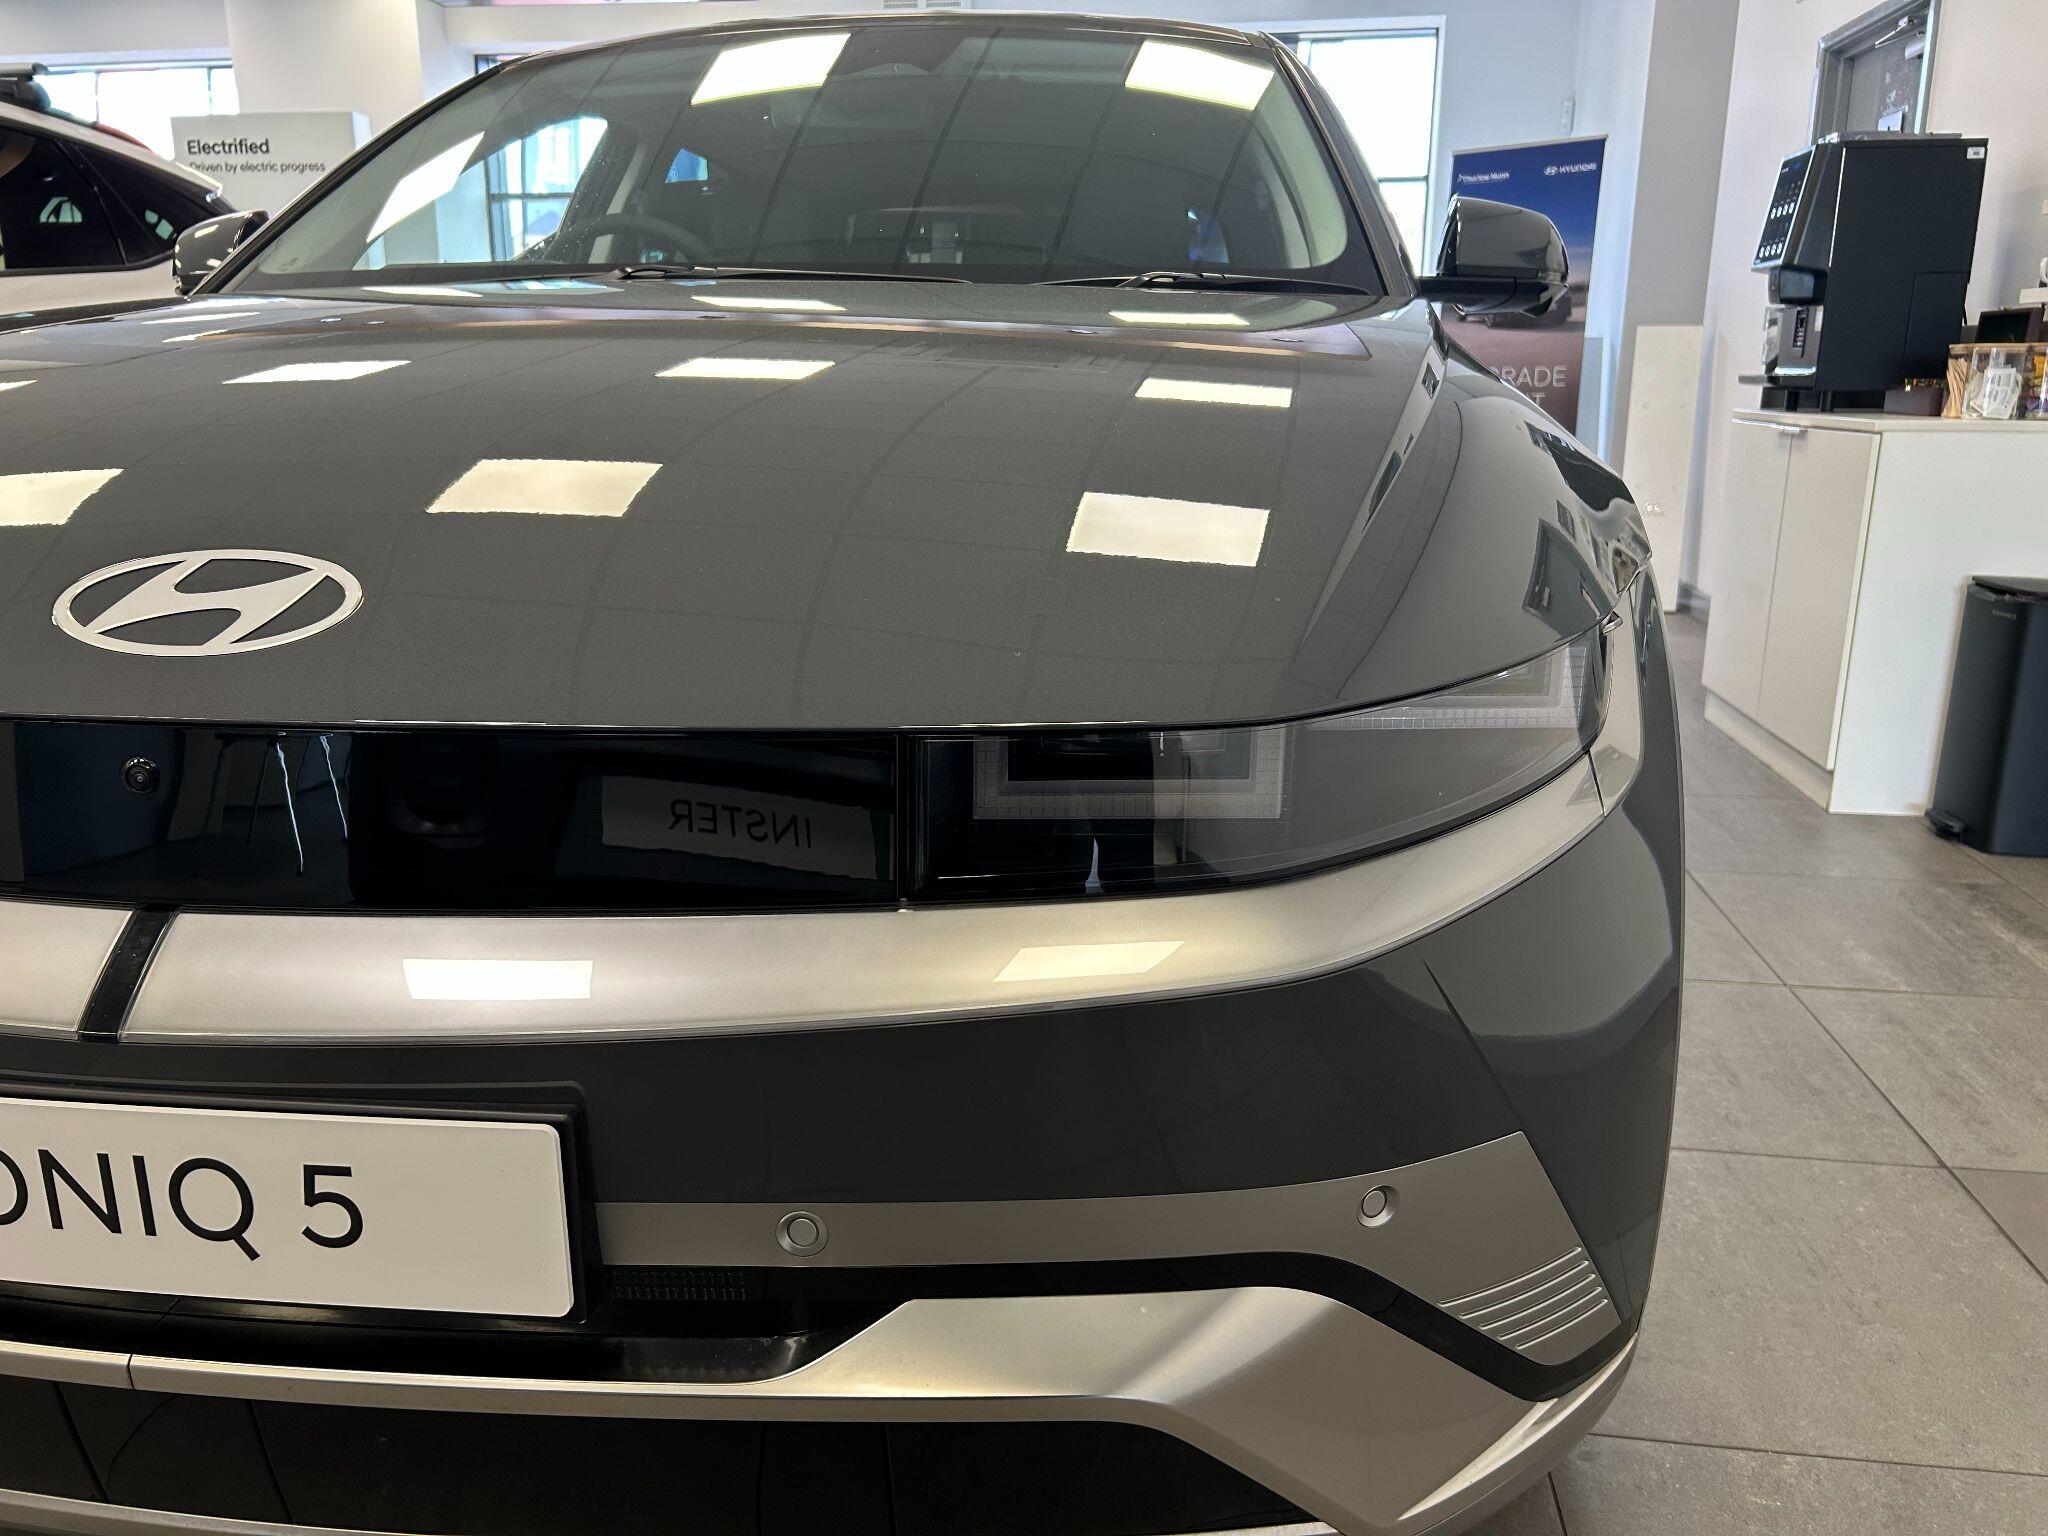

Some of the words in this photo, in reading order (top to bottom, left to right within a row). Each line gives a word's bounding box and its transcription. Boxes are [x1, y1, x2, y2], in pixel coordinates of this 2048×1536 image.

[187, 138, 270, 155] Electrified
[225, 161, 237, 174] by
[240, 160, 278, 172] electric
[281, 162, 326, 174] progress
[1489, 366, 1568, 388] RADE
[301, 1163, 364, 1249] 5
